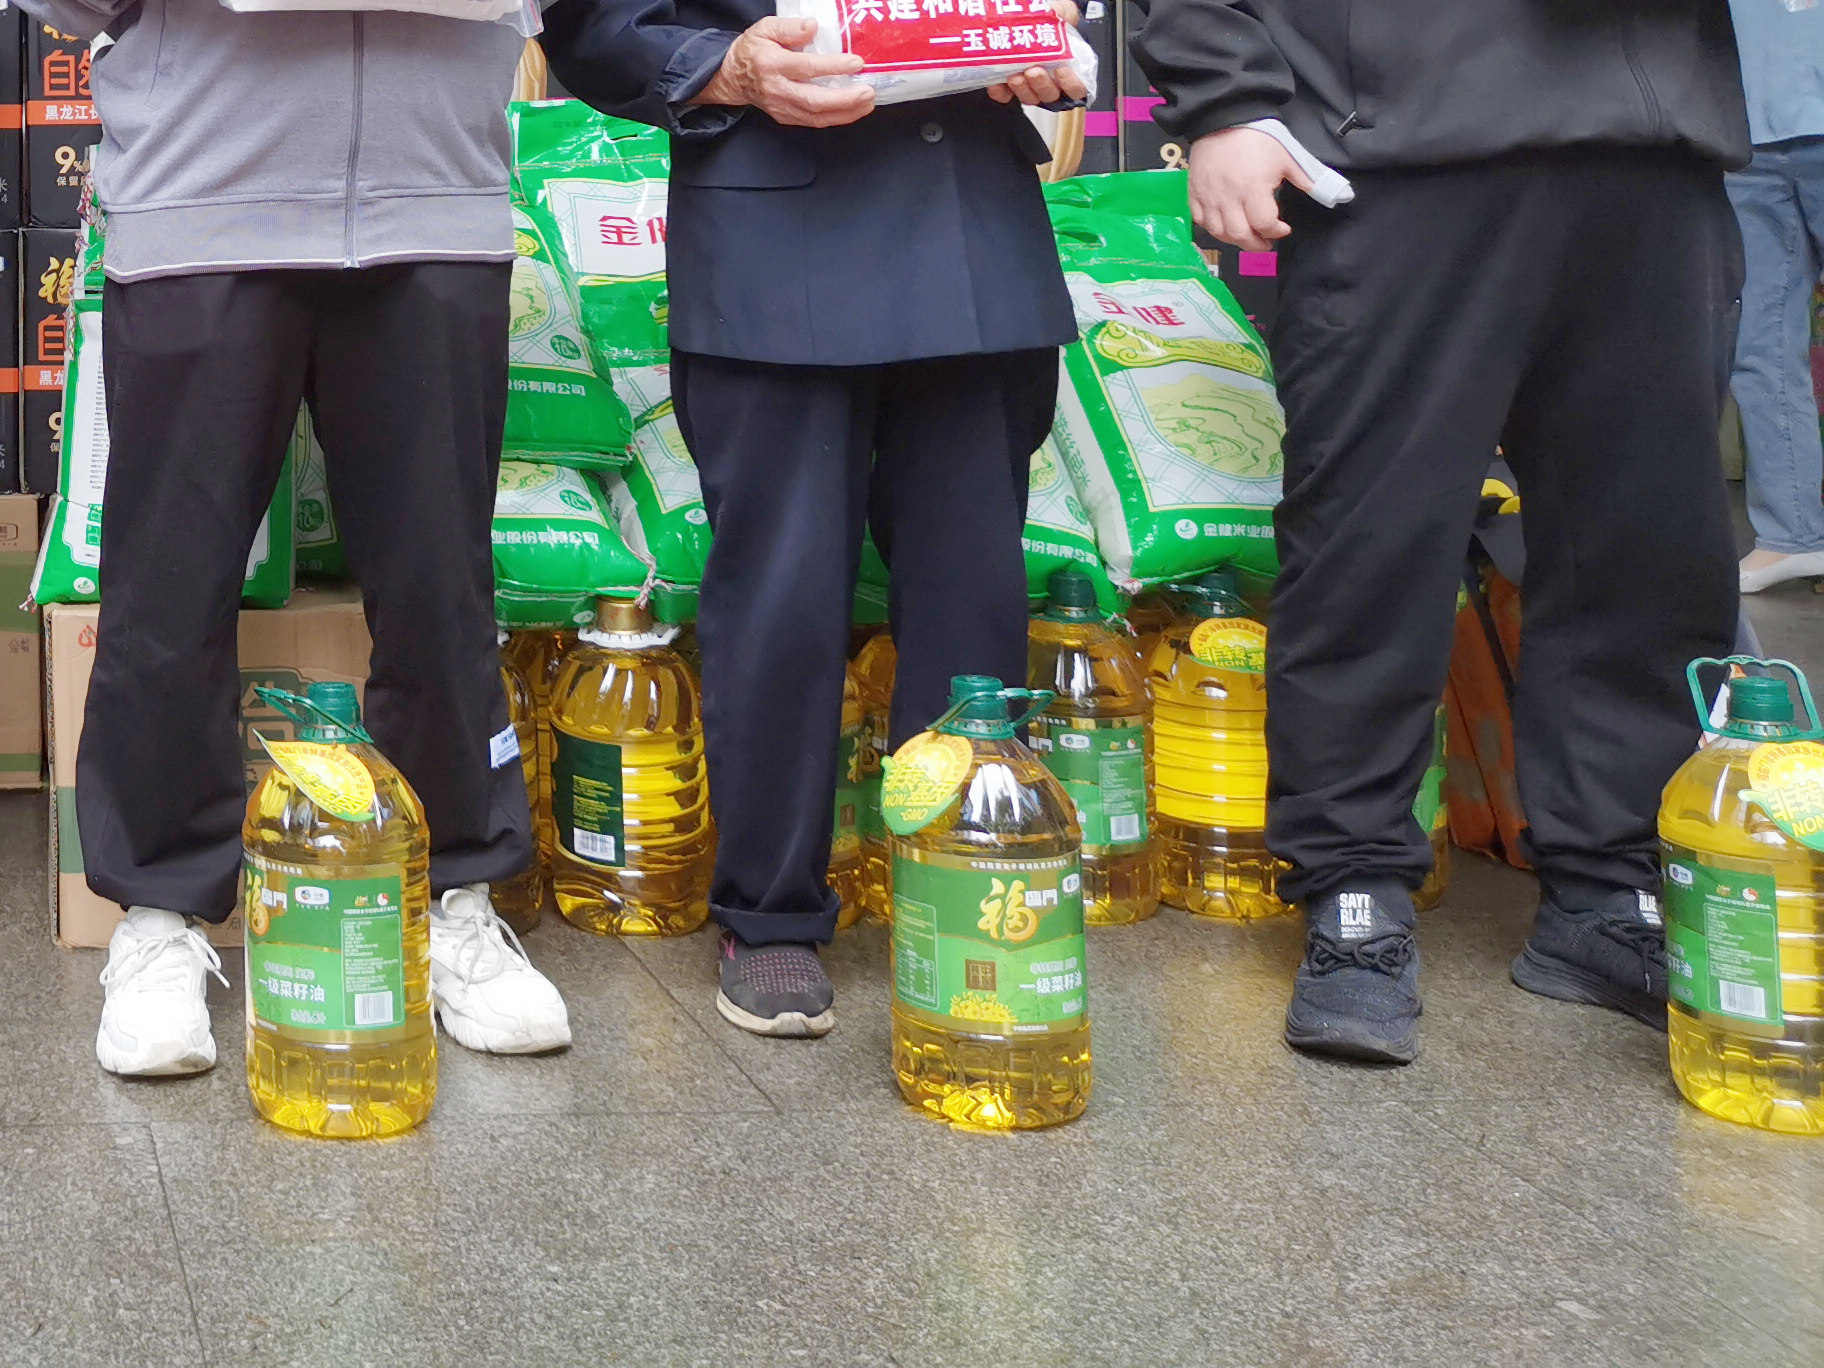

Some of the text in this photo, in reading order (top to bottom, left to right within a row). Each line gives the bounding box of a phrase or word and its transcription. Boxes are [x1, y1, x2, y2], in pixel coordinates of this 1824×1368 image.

[509, 381, 586, 397] 份有限公司
[977, 877, 1039, 942] 福
